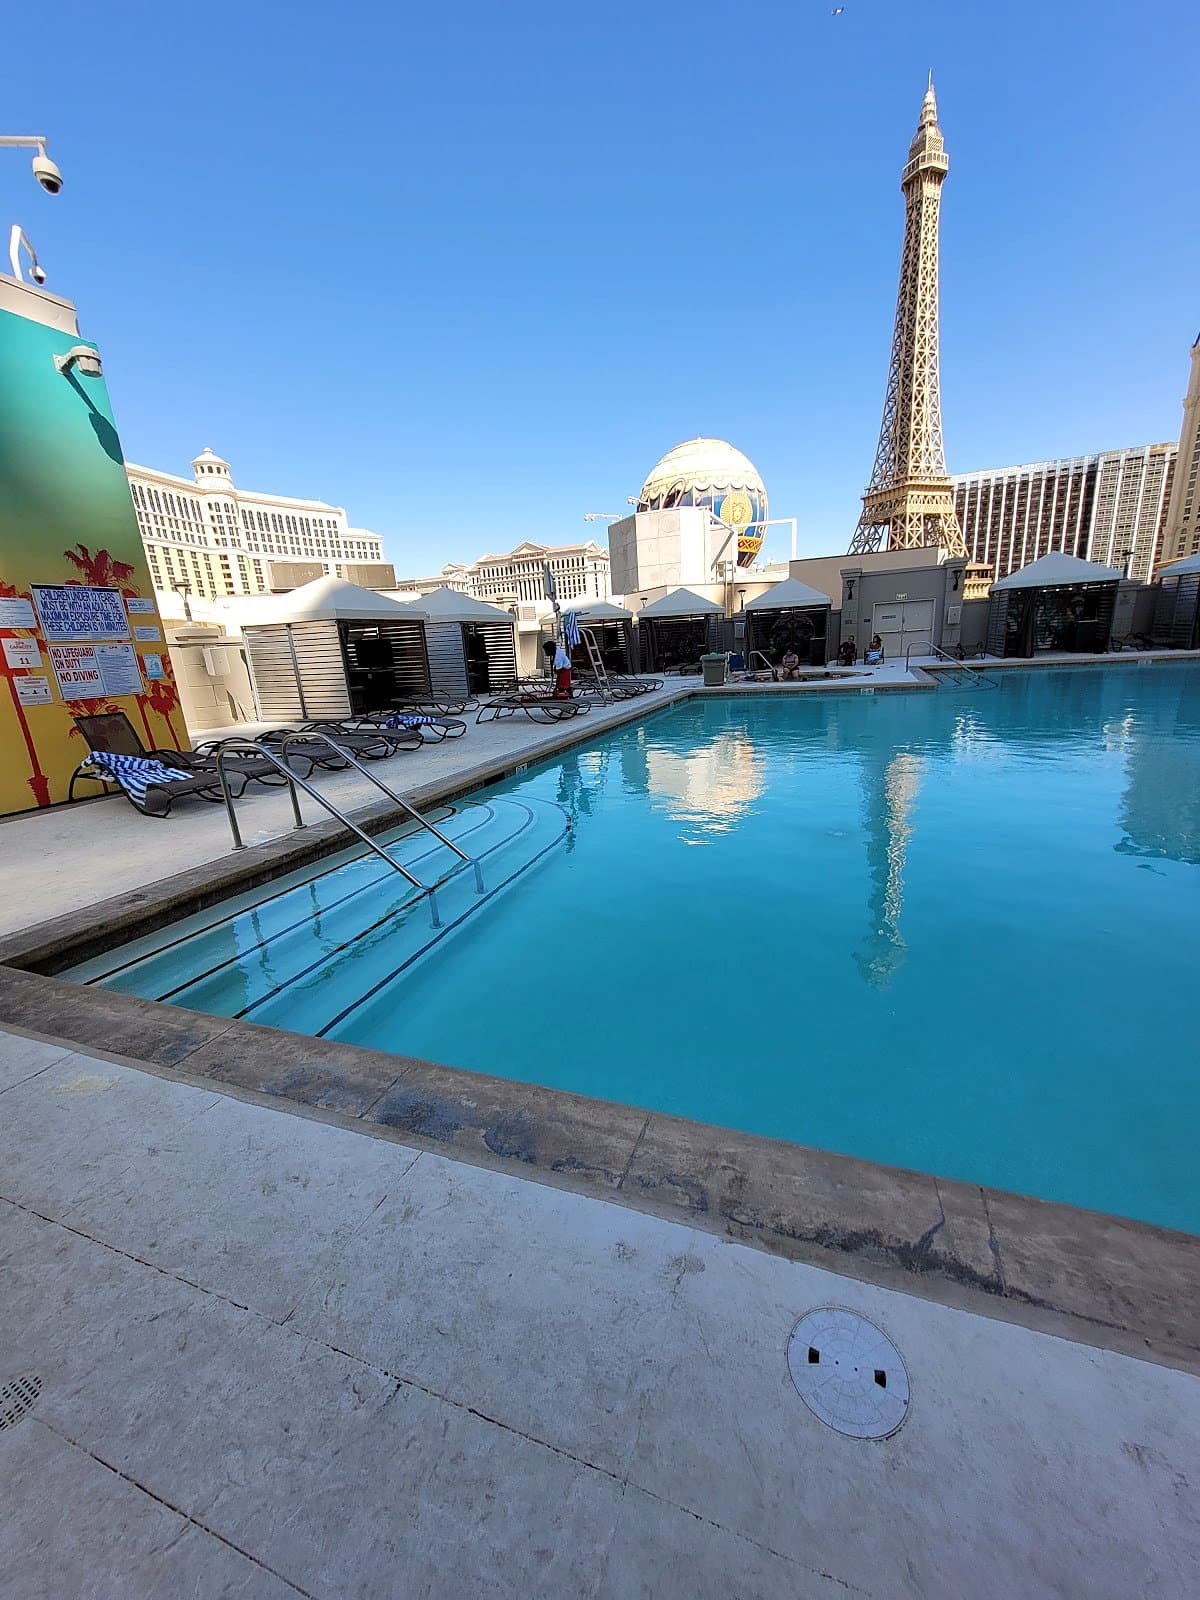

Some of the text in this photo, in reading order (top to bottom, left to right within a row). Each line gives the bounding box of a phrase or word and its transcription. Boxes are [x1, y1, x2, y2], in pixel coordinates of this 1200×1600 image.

[40, 590, 70, 601] CHILDREN
[70, 591, 91, 601] UNDER
[97, 592, 115, 602] YEARS
[41, 600, 58, 611] MUST
[59, 601, 68, 611] BE
[69, 601, 82, 611] WITH
[83, 601, 92, 611] AN
[109, 602, 120, 612] THE
[41, 611, 124, 622] MAXIMUM EXPOSURE TIME FOR
[43, 621, 64, 631] THESE
[65, 621, 93, 631] CHILDREN
[93, 621, 99, 632] IS
[104, 621, 128, 631] MINUTES
[51, 647, 94, 659] NO LIFEGUARD
[55, 659, 65, 669] ON
[65, 658, 81, 669] DUTY
[60, 670, 99, 682] NO DIVING
